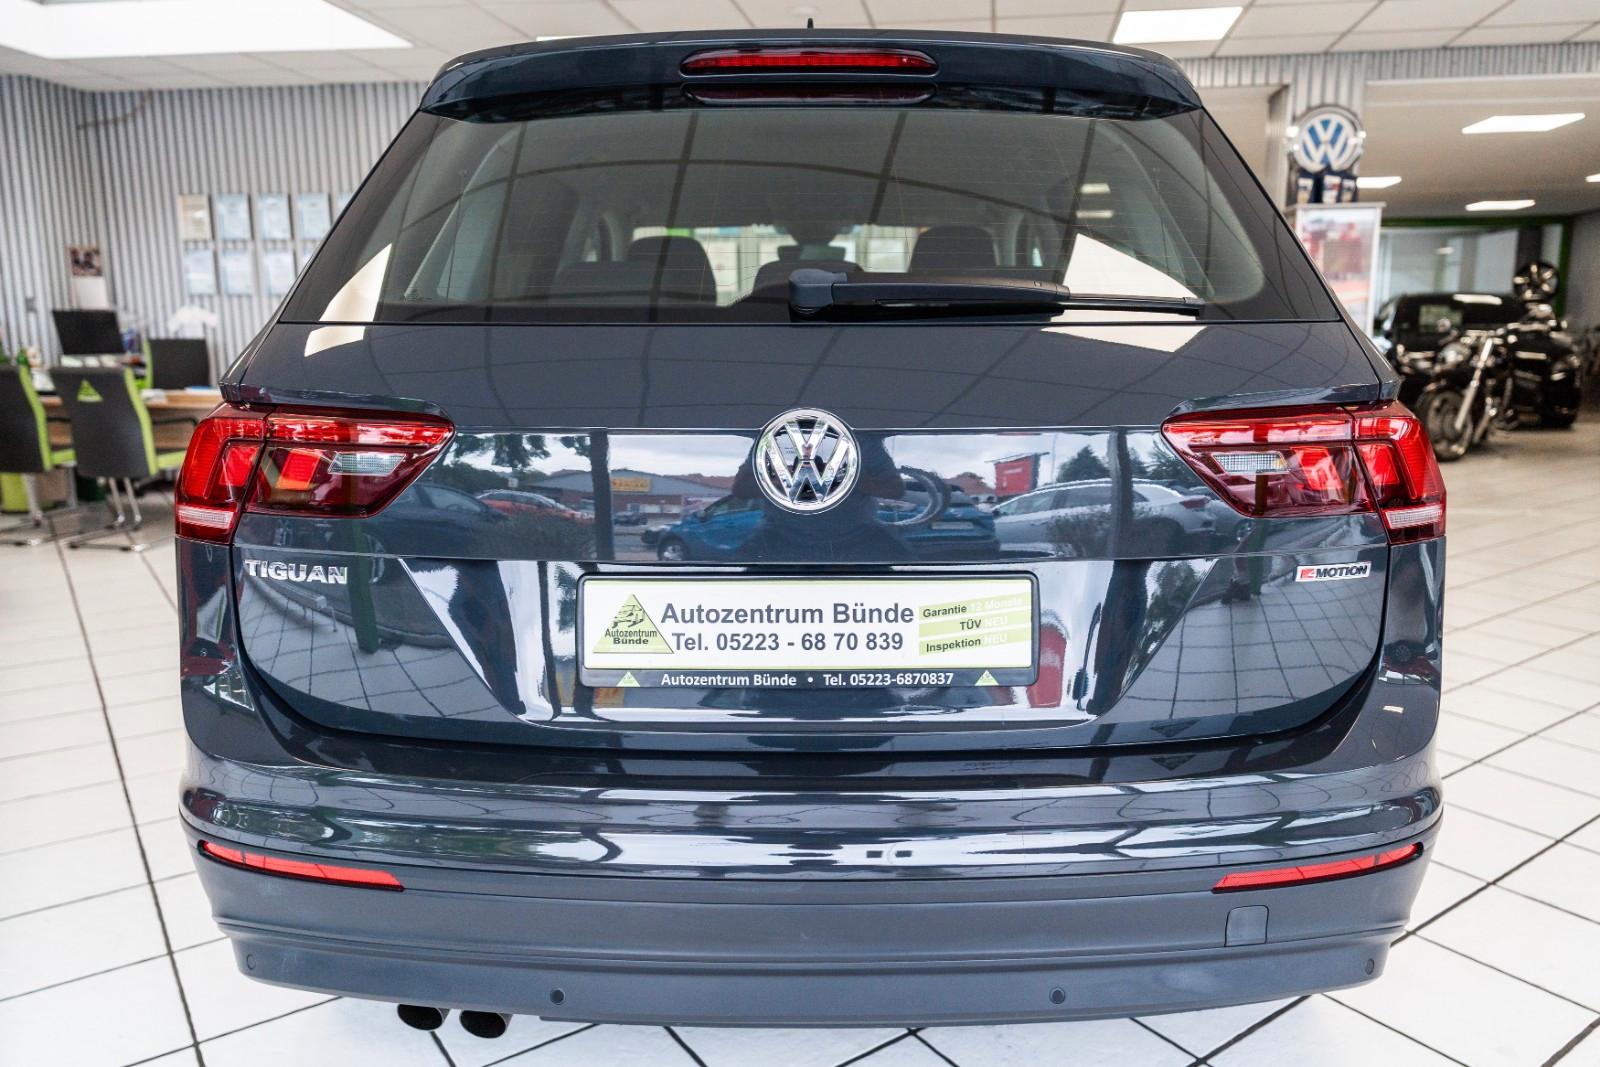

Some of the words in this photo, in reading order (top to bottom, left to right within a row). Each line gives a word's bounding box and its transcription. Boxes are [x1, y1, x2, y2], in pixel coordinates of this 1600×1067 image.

[244, 559, 348, 585] TIGUAN
[661, 603, 823, 624] Autozentrum
[833, 603, 914, 624] Bünde
[922, 604, 967, 618] Garantie
[959, 619, 982, 631] TÜV
[604, 628, 658, 638] Autozentrum
[613, 637, 649, 645] Bünde
[672, 632, 709, 651] Tel.
[716, 632, 779, 651] 05223
[801, 632, 826, 651] 68
[833, 632, 859, 651] 70
[865, 632, 903, 651] 839
[926, 637, 981, 653] Inspektion
[661, 673, 749, 686] Autozentrum
[753, 673, 797, 686] Bünde
[823, 674, 846, 686] Tel.
[850, 672, 954, 686] 05223-6870837
